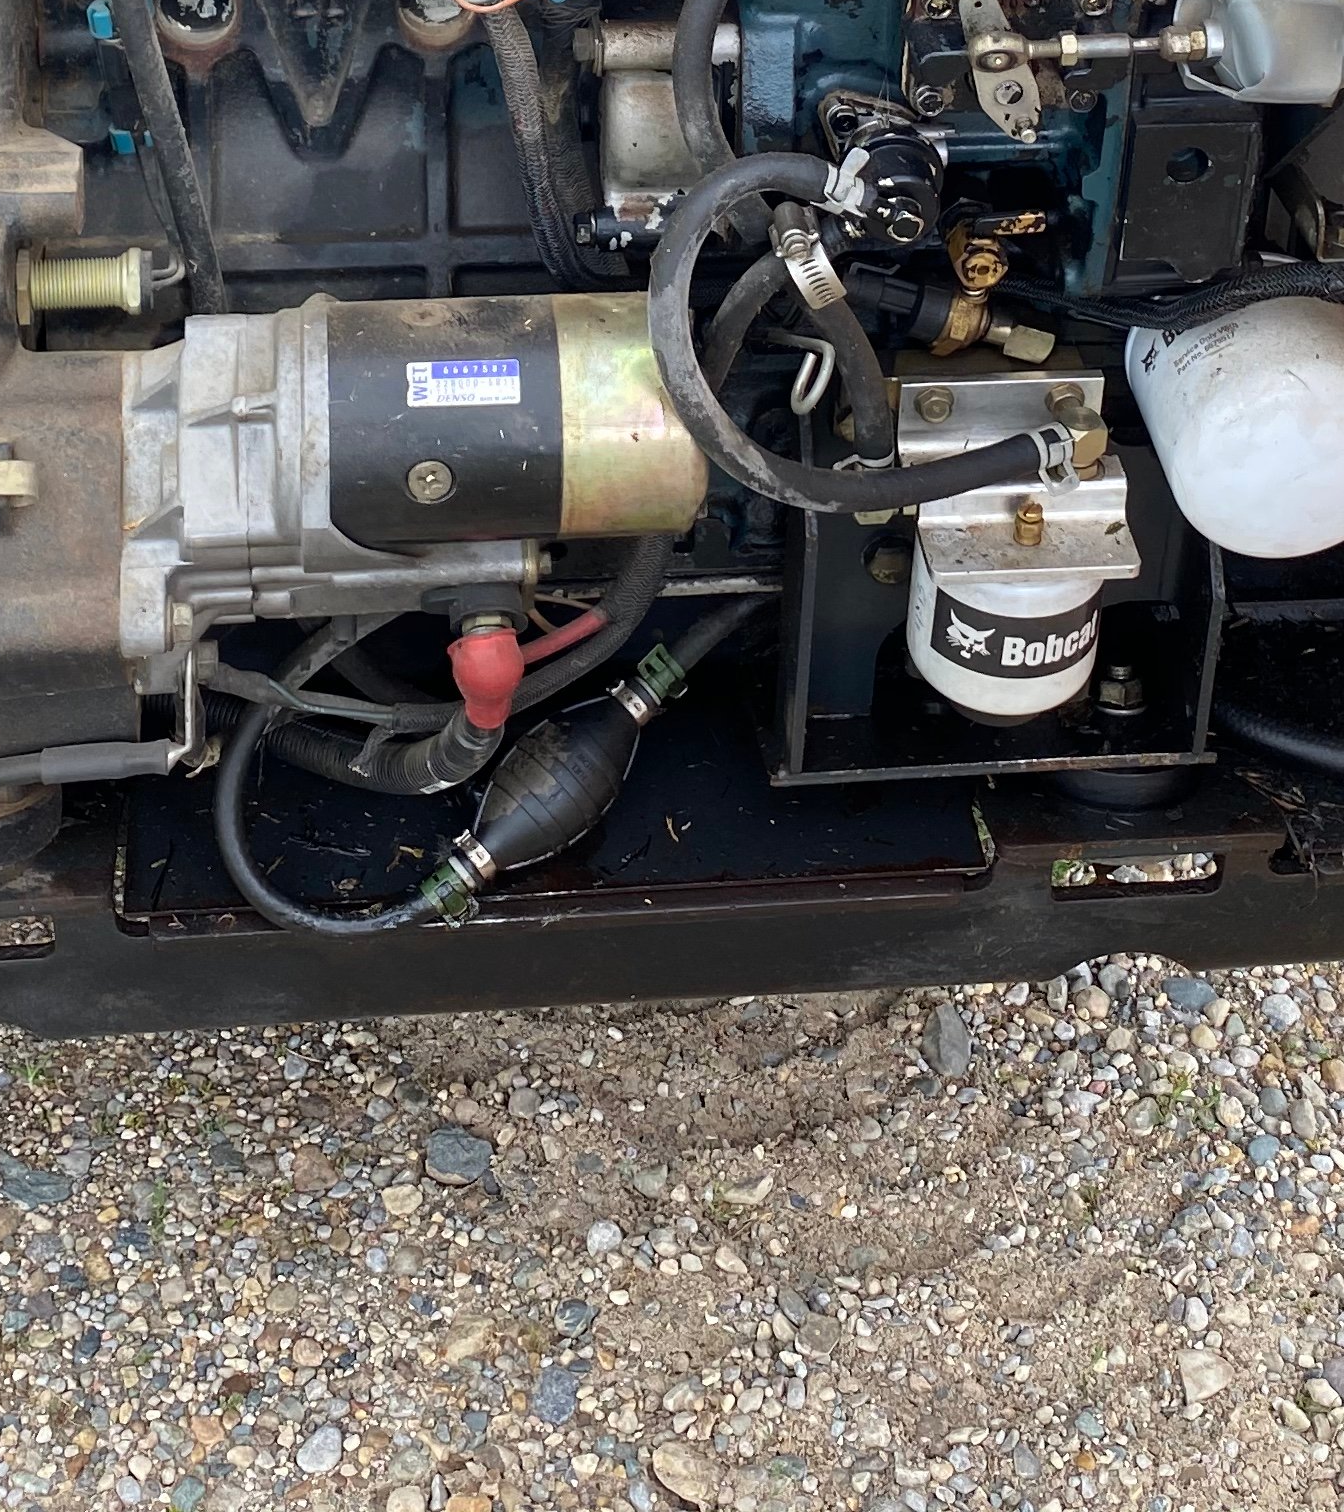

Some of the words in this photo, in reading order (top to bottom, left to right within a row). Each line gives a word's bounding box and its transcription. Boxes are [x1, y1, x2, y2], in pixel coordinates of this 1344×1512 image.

[442, 364, 508, 376] 6667587
[1176, 358, 1191, 375] Part
[412, 365, 429, 402] WET
[436, 392, 476, 403] DENSO
[1001, 609, 1099, 667] Bobcat
